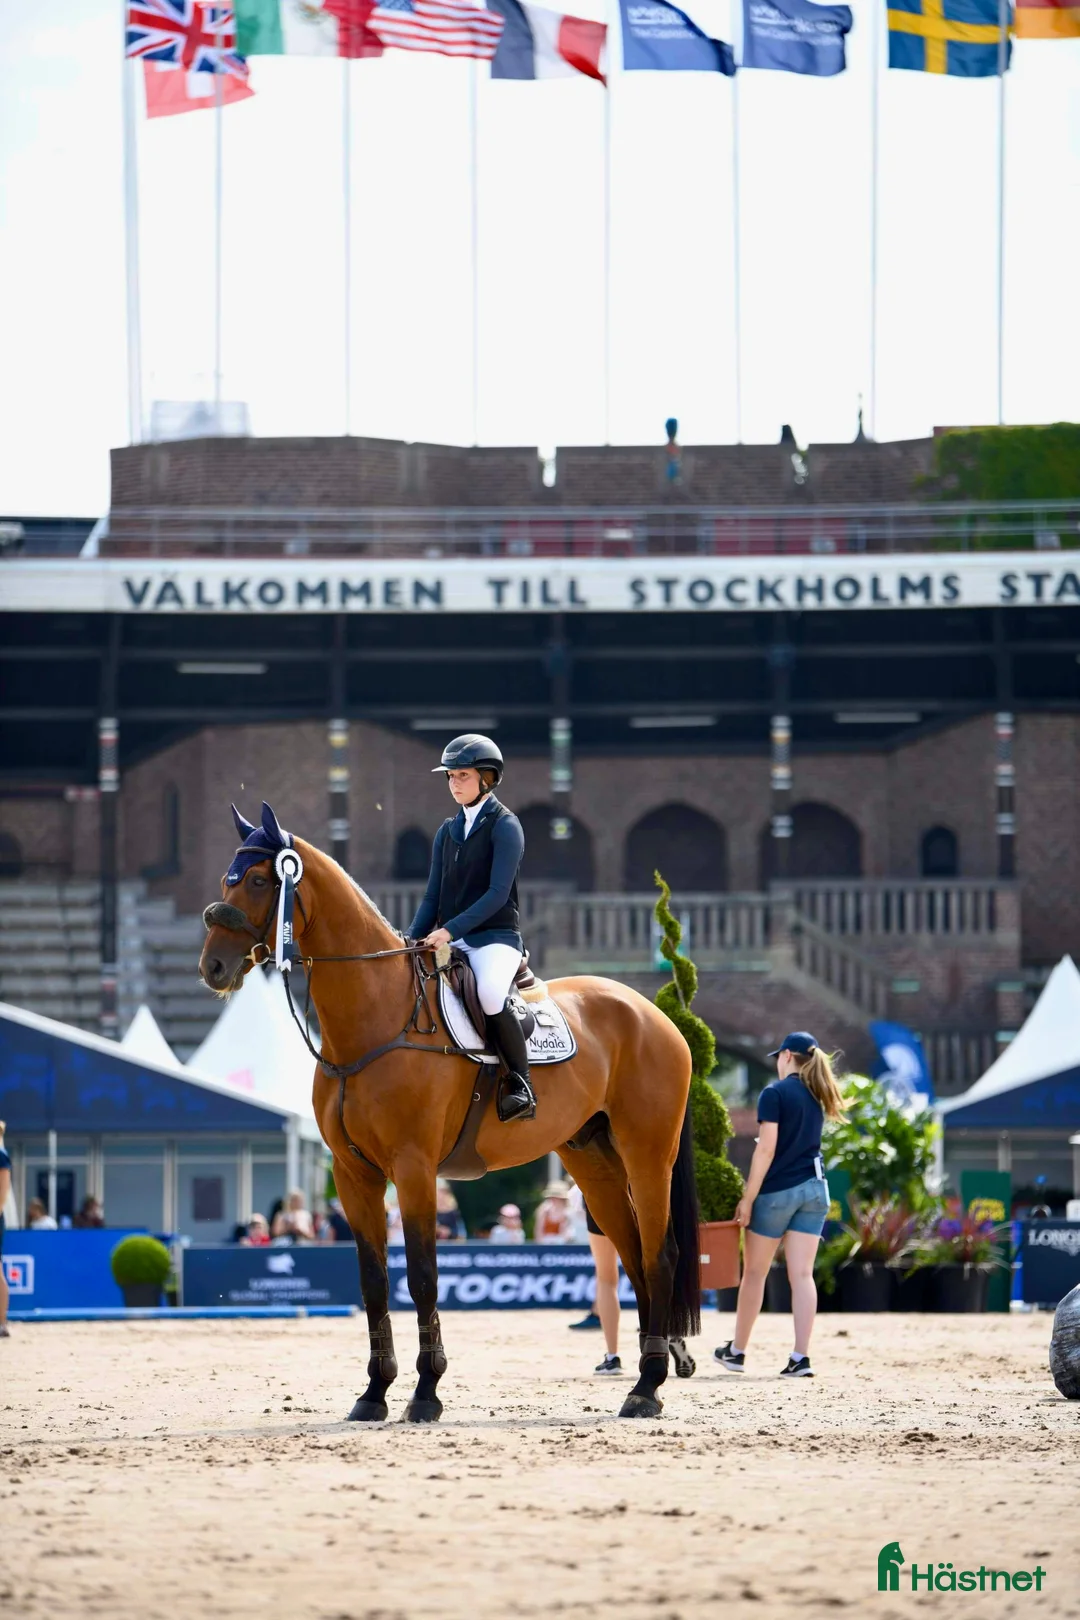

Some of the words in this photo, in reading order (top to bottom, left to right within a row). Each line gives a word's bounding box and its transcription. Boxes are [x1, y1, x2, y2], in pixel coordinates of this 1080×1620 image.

[122, 575, 444, 607] VÄLKOMMEN
[487, 578, 587, 606] TILL
[629, 573, 961, 605] STOCKHOLMS
[529, 1037, 565, 1050] Nydala
